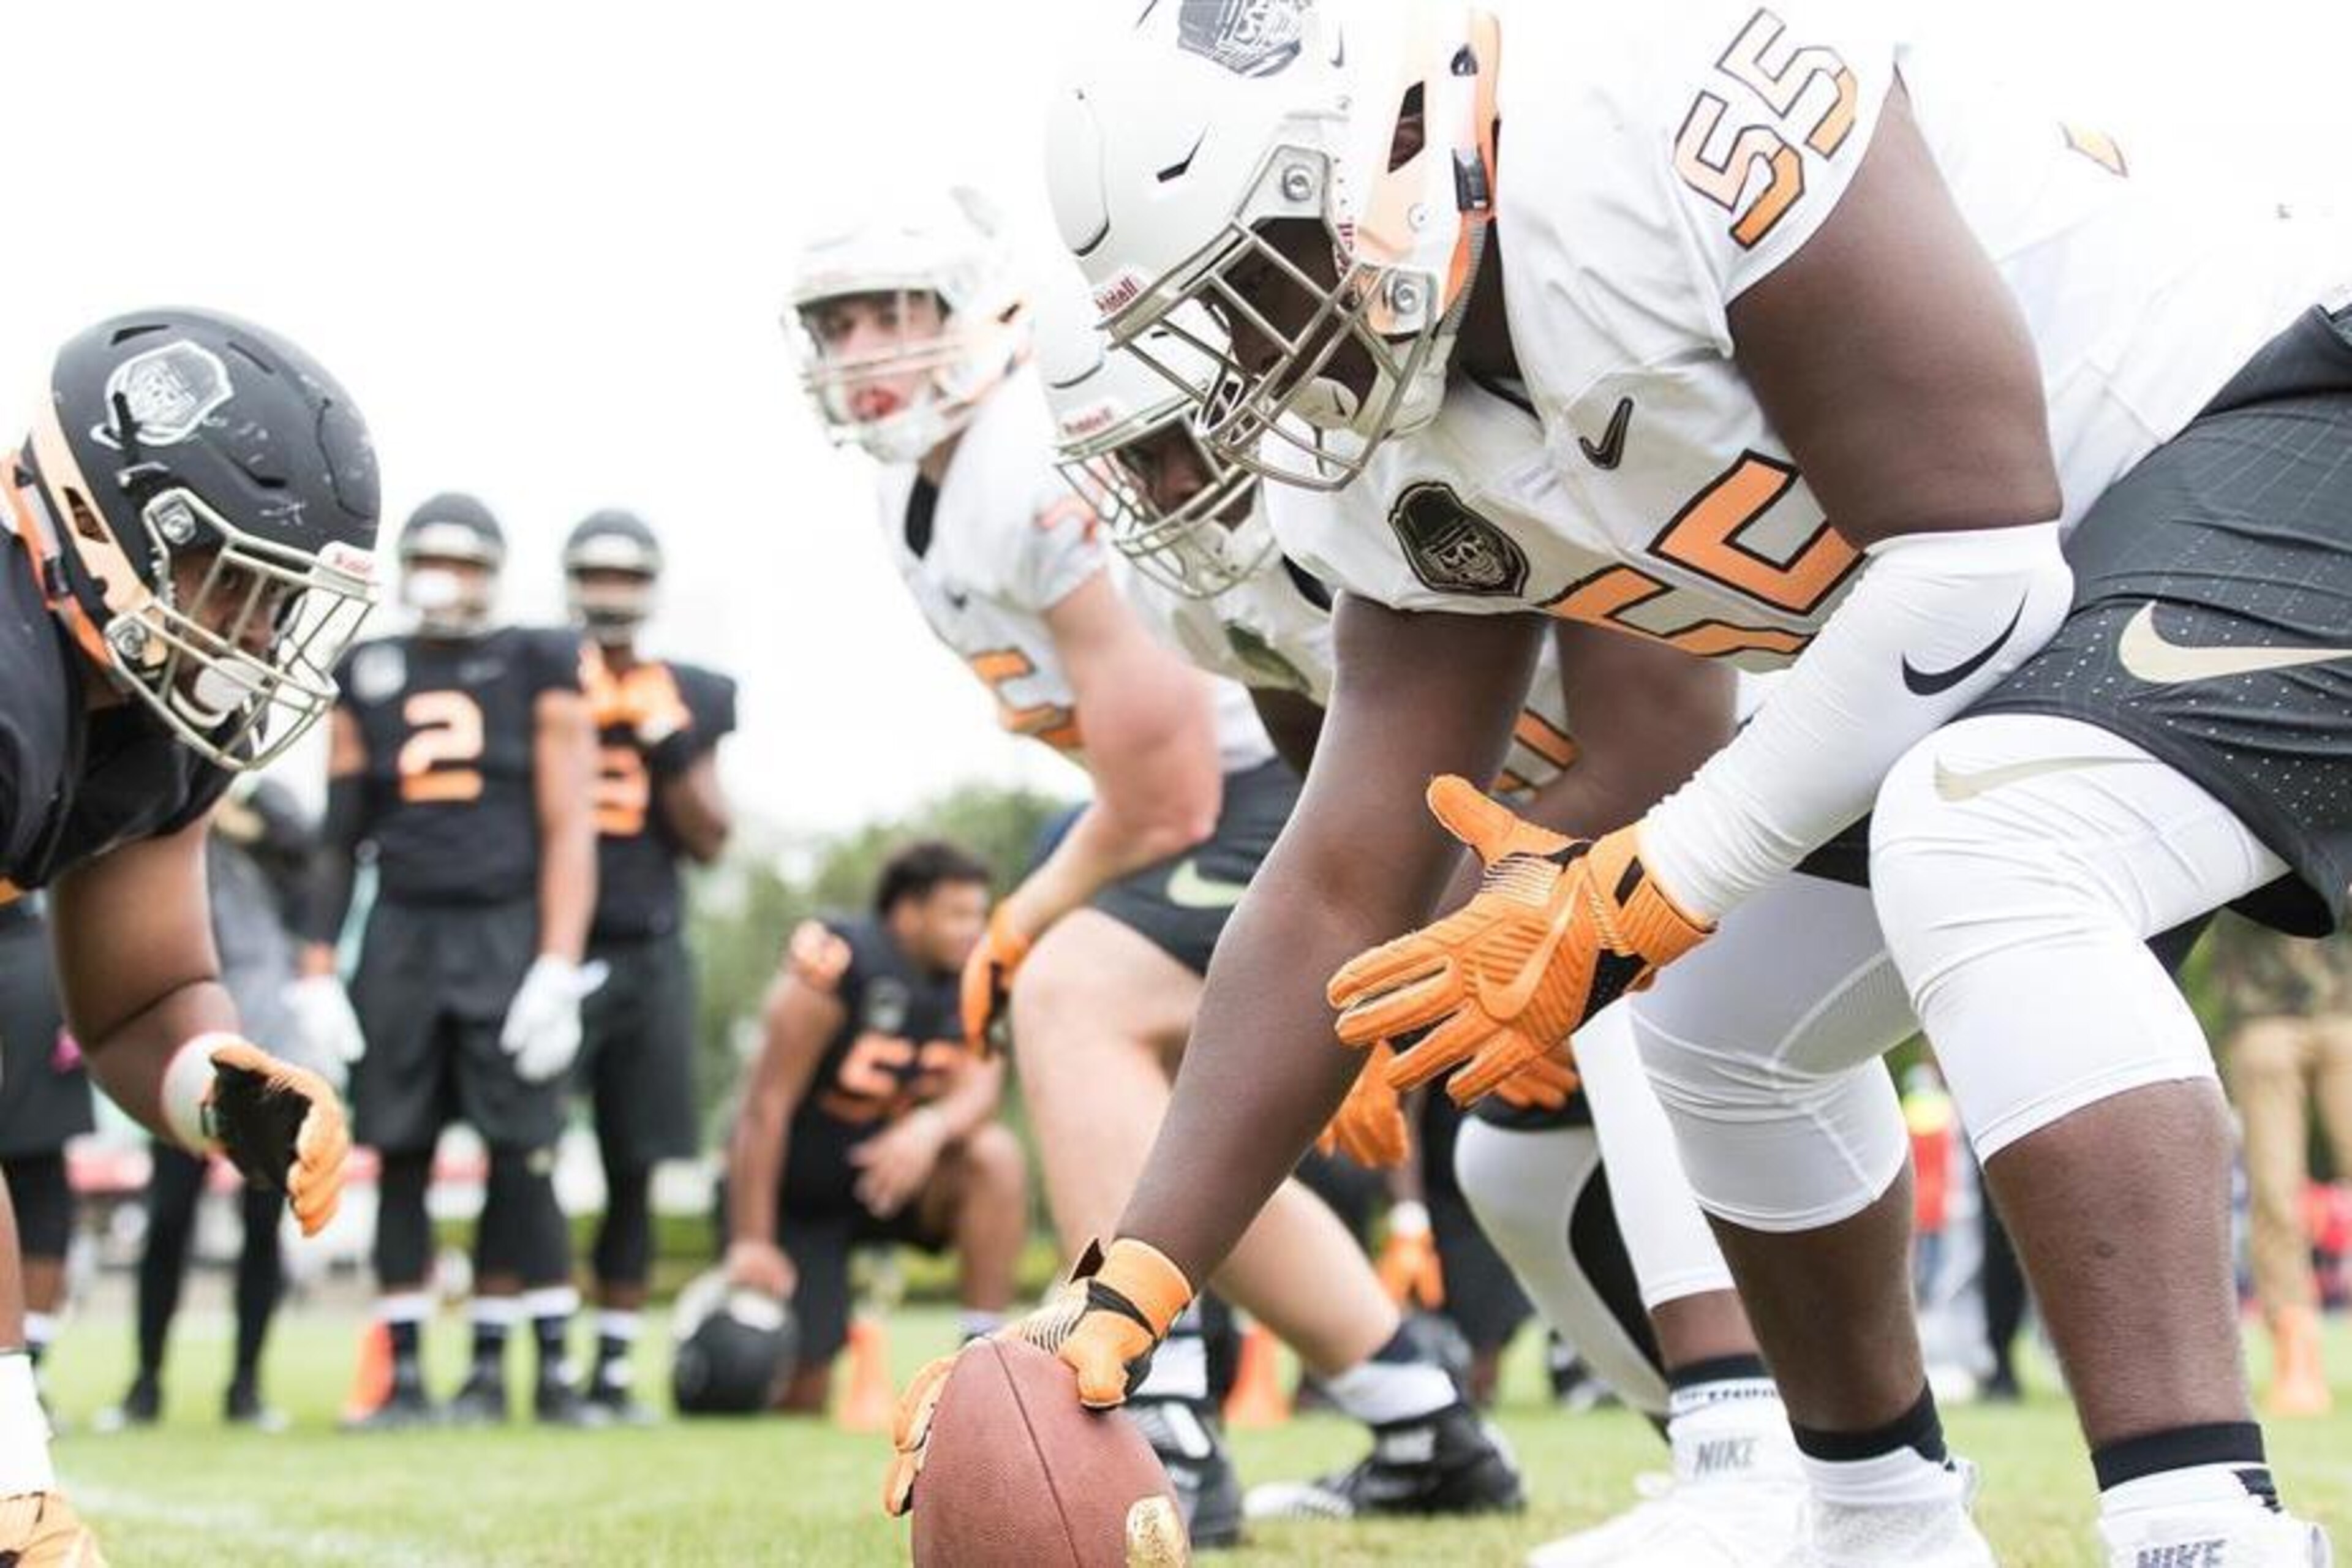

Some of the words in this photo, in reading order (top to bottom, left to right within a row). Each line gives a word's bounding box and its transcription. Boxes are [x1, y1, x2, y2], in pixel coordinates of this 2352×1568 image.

[1673, 7, 1858, 251] 55
[399, 690, 484, 802] 2
[1694, 1438, 1757, 1476] NIKE
